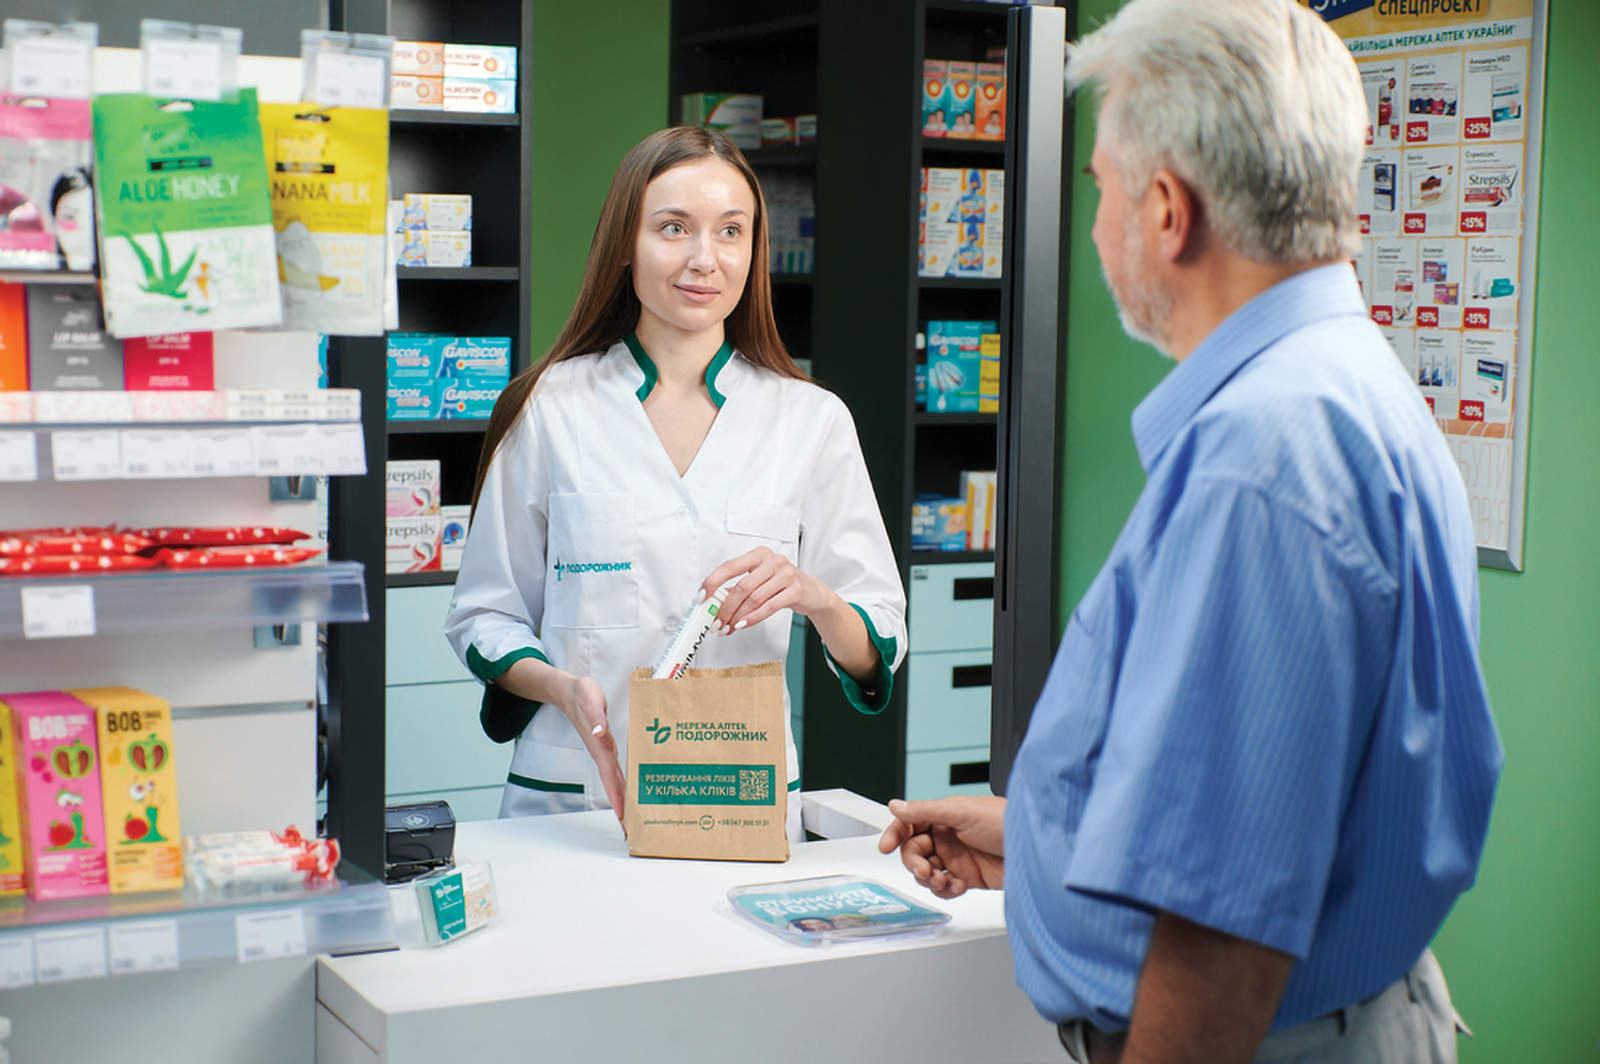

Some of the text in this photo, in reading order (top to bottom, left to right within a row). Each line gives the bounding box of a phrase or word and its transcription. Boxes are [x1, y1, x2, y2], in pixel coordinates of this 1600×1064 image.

[1346, 38, 1394, 52] АЙБІЛЬША
[1395, 34, 1433, 48] МЕРЕЖА
[1435, 30, 1465, 43] АПТЕК
[1469, 173, 1511, 186] Strepsils
[1461, 217, 1484, 228] -15%
[1465, 313, 1487, 324] -15%
[444, 345, 508, 358] GAVISCON
[445, 388, 502, 401] GAVISCO
[1461, 405, 1482, 418] -10%
[386, 523, 436, 539] repsils
[566, 561, 632, 574] ПОДОРОЖНИК
[29, 715, 68, 740] BOB
[107, 711, 142, 733] BOB
[676, 722, 748, 731] МЕРЕЖА АПТЕК
[676, 731, 768, 742] ПОДОРОЖНИК
[645, 774, 736, 783] РЕЗЕРВУВАННЯ ЛІКІВ
[645, 785, 736, 796] У КІЛЬКА КЛІКІВ
